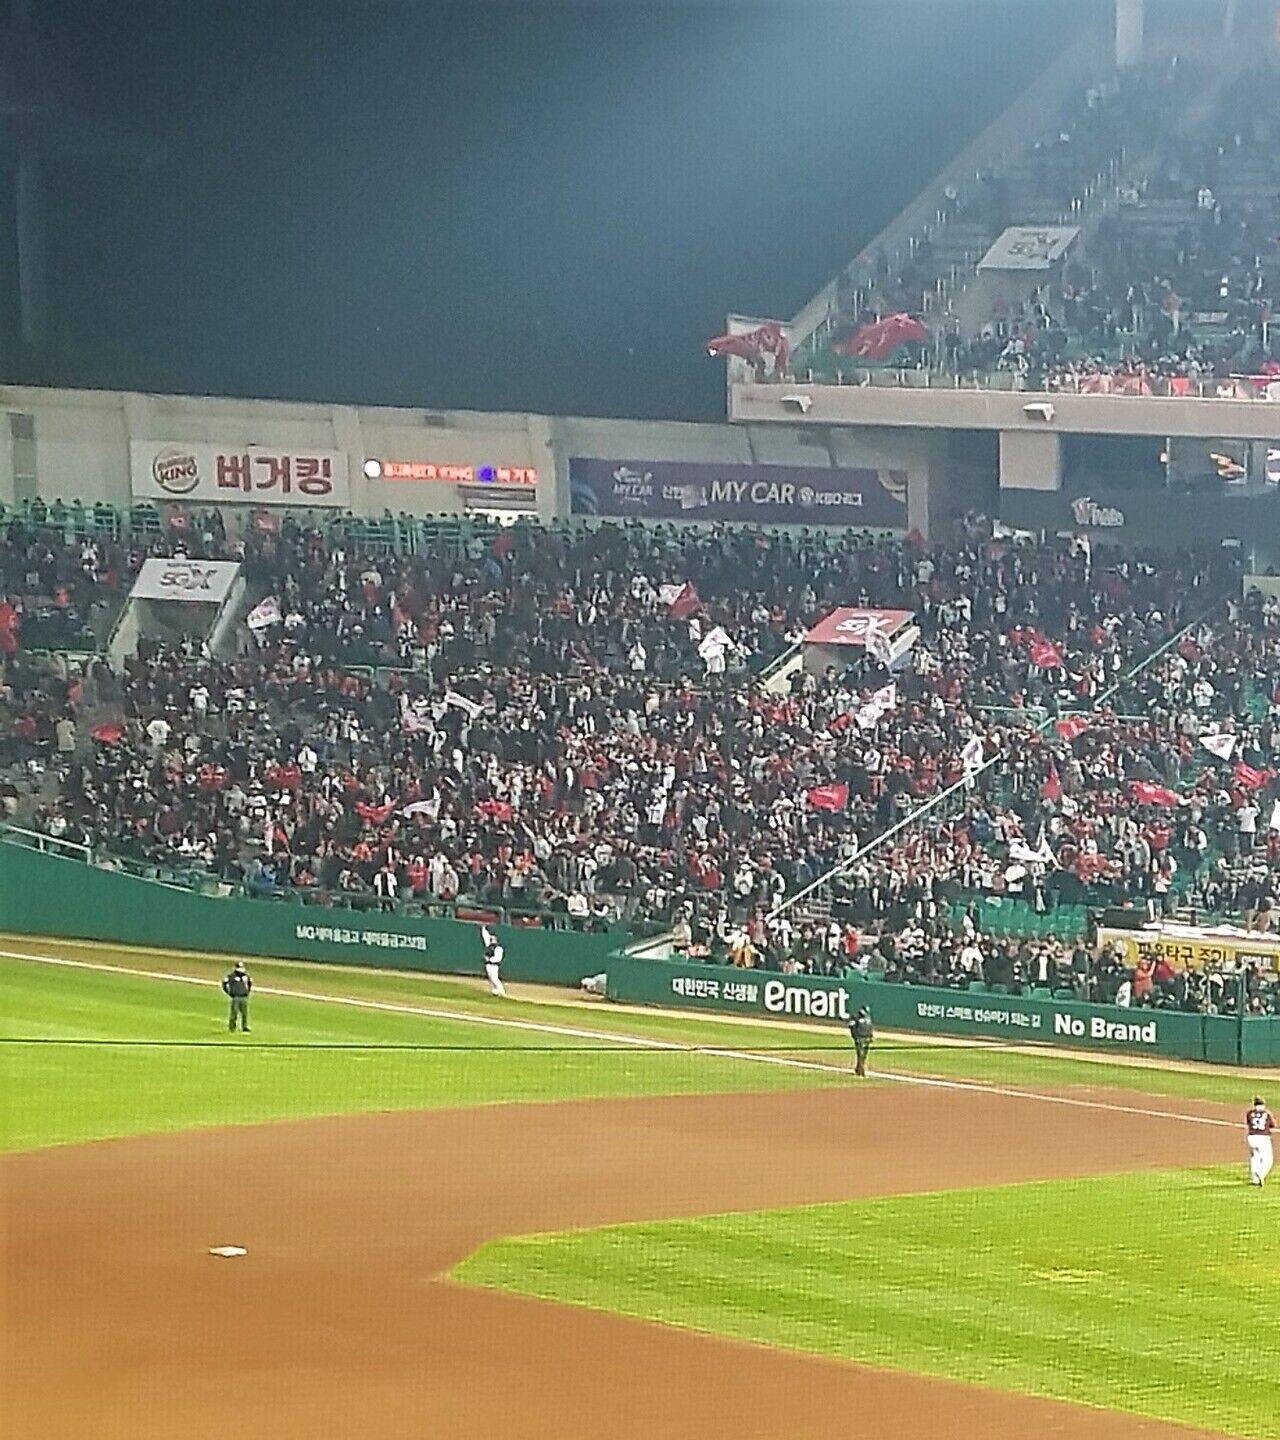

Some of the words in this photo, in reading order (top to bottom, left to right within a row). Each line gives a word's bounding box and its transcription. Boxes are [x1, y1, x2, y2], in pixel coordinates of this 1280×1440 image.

[159, 466, 198, 481] KING
[216, 454, 334, 493] 버거킹
[711, 480, 748, 503] MY
[750, 481, 794, 505] CAR
[671, 977, 720, 999] 대한민국
[722, 982, 759, 1003] 신생활
[763, 979, 851, 1020] emart
[1054, 1012, 1086, 1037] No
[1091, 1016, 1157, 1044] Brand
